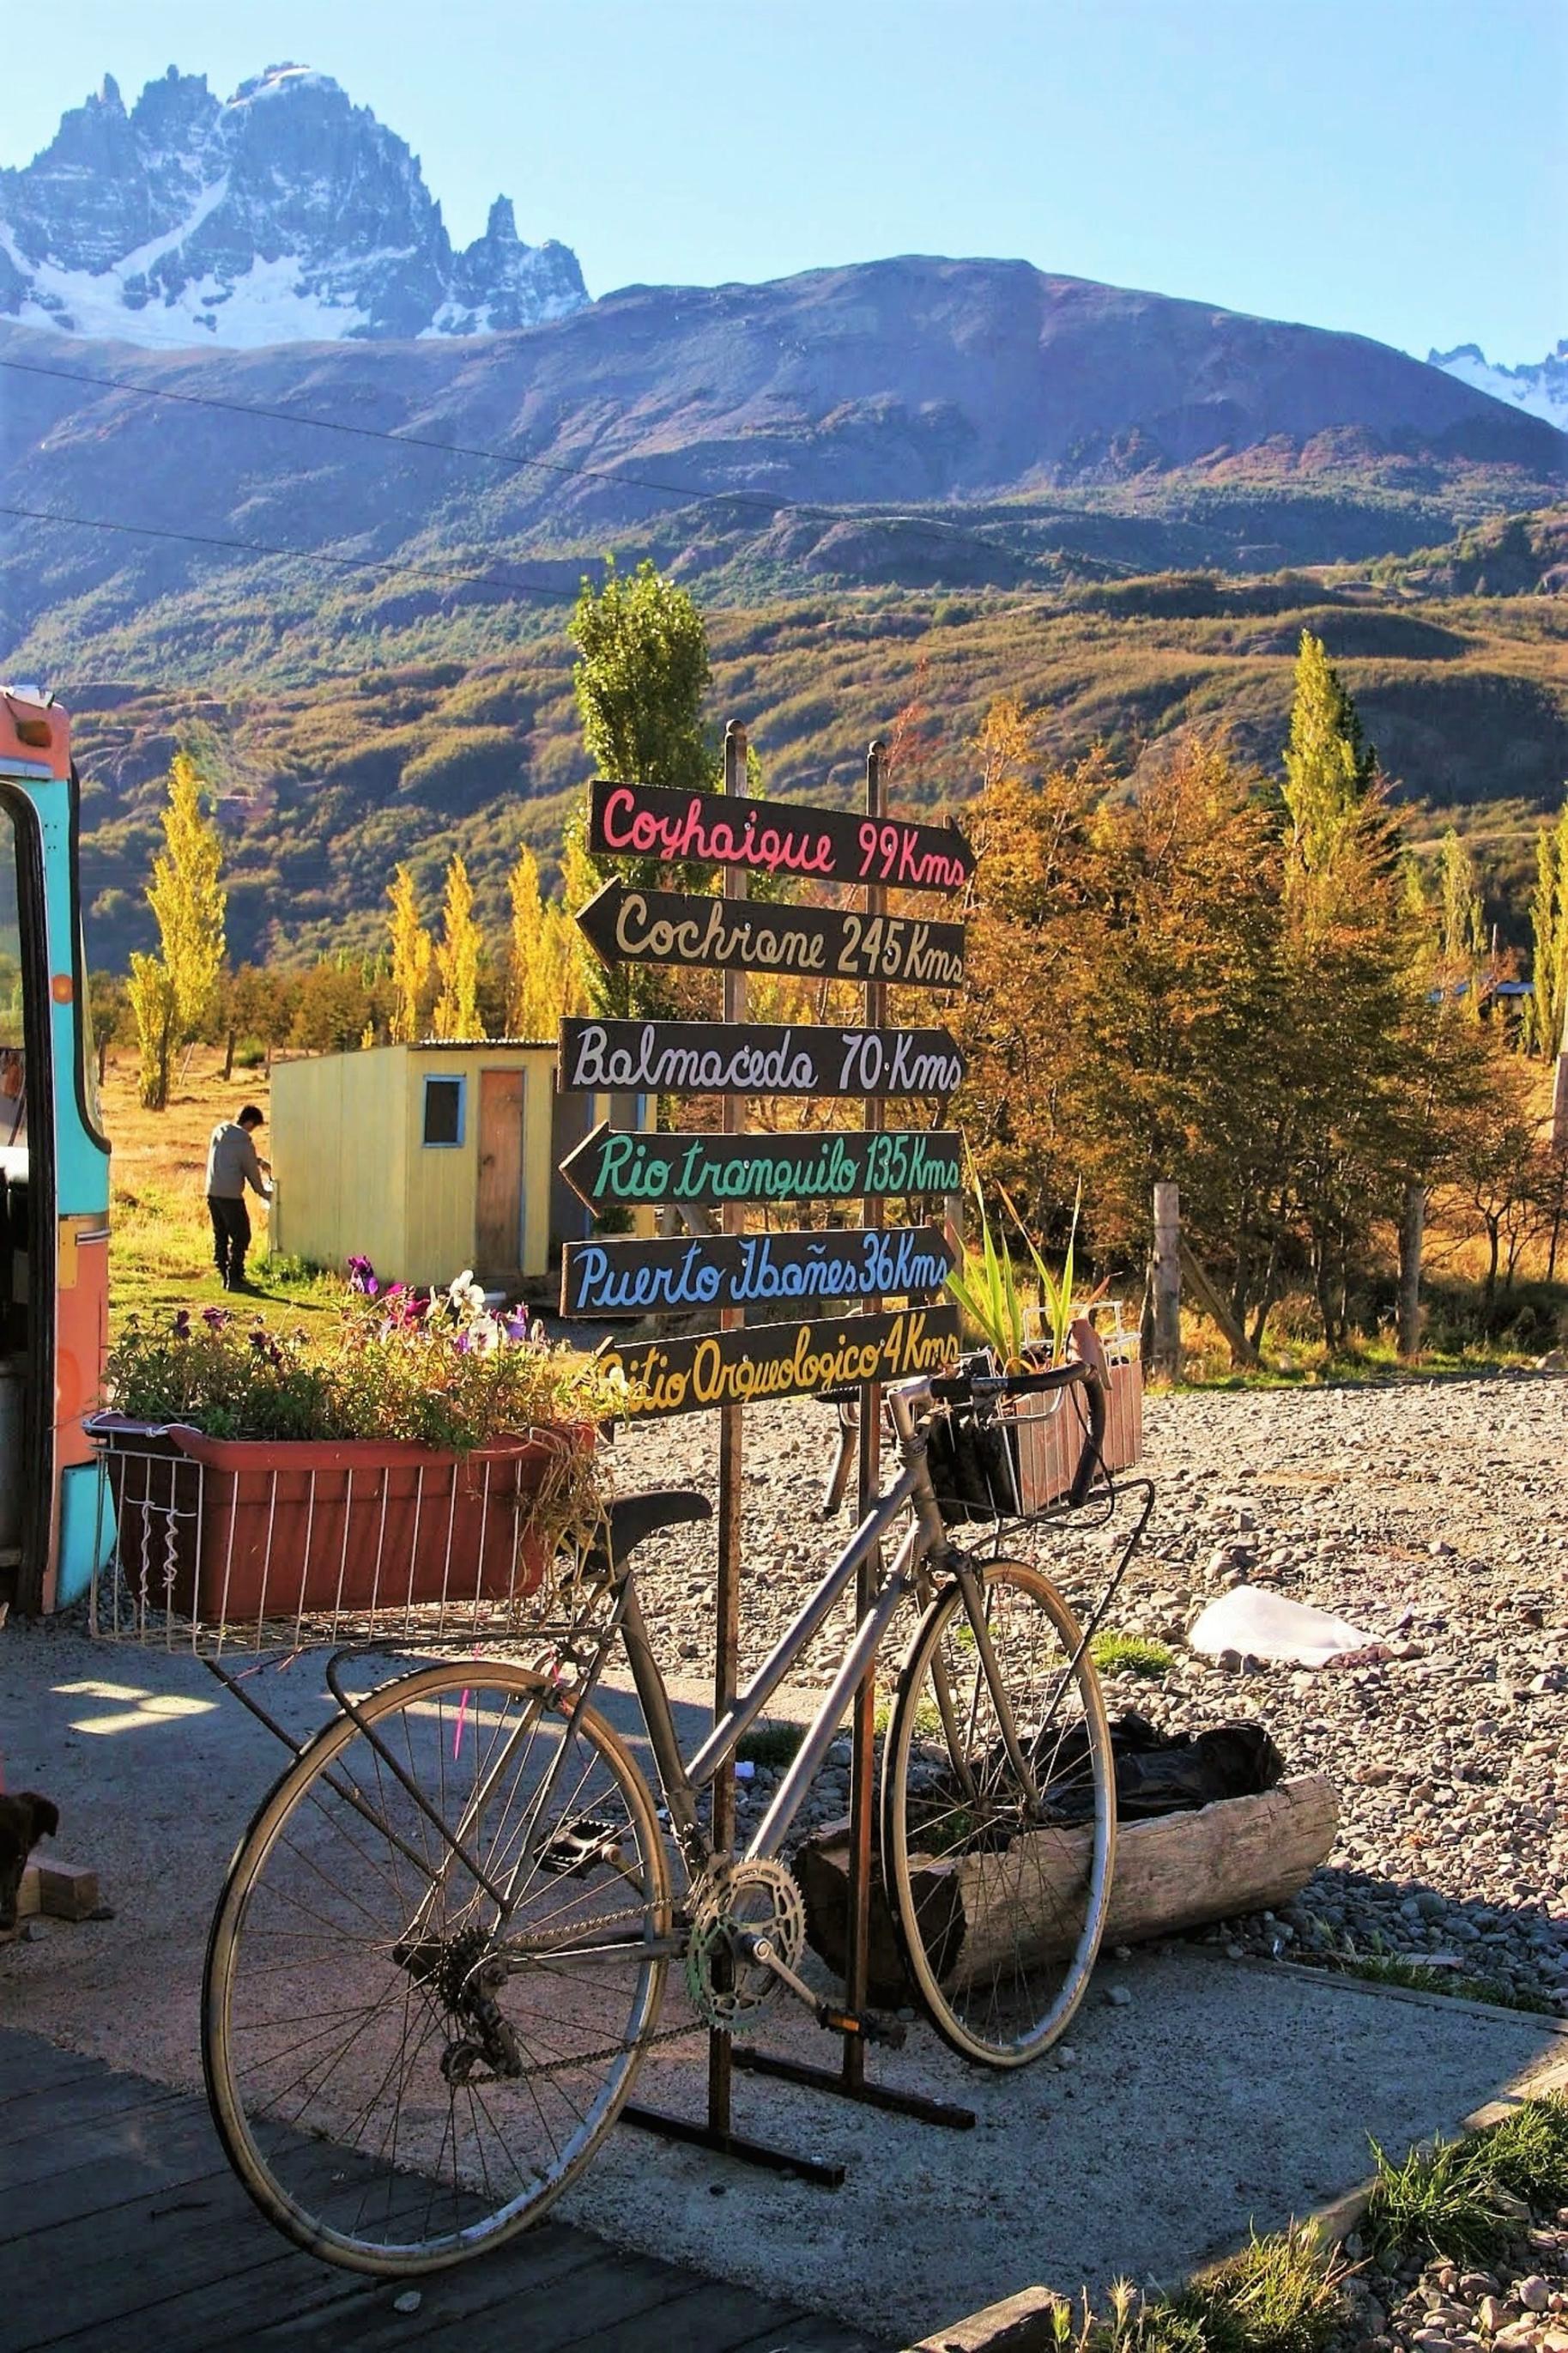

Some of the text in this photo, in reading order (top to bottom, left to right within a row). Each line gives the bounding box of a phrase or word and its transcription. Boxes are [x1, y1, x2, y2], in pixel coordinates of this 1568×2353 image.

[603, 789, 836, 872] Coyhaique
[616, 895, 826, 968] Cochrane
[572, 1025, 818, 1089] Balmaceda
[592, 1136, 673, 1198] Rio
[674, 1137, 861, 1201] tranquilo
[572, 1240, 726, 1308] Puerto
[730, 1237, 857, 1301] Ibañes
[693, 1325, 881, 1403] Arqueologico
